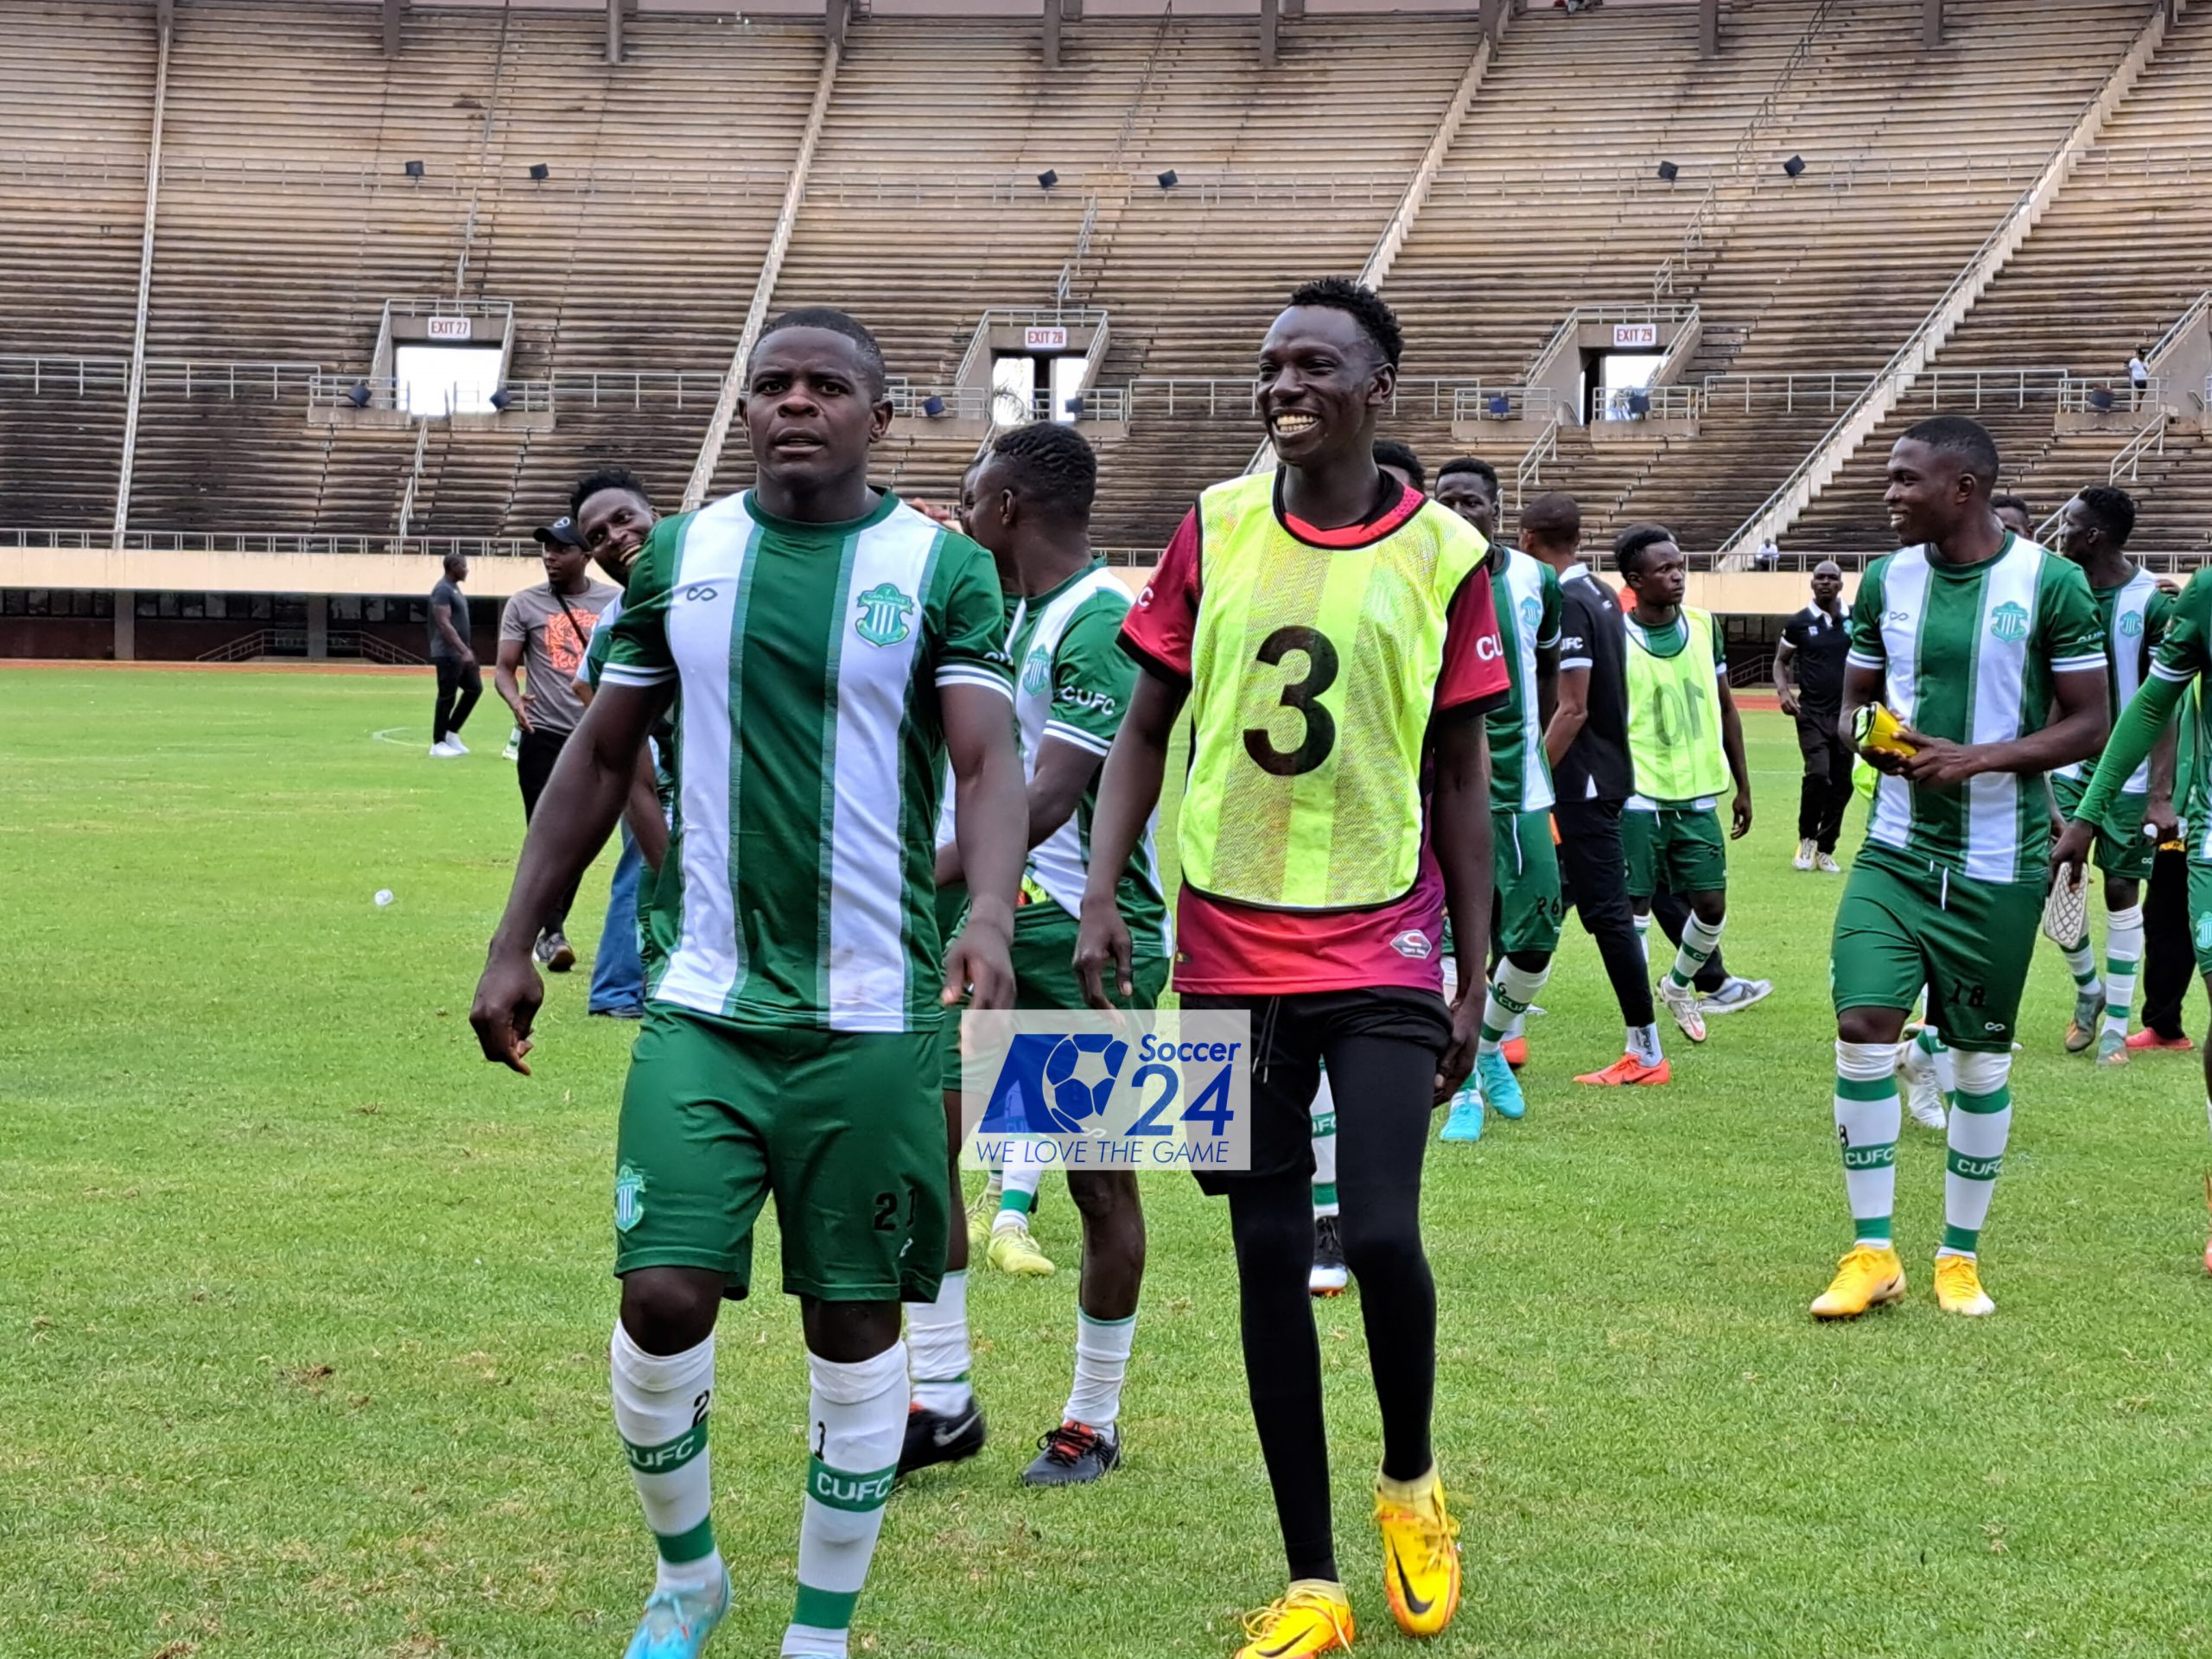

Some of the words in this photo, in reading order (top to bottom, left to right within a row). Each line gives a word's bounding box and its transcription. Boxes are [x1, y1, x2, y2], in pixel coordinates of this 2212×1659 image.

[431, 321, 454, 334] EXIT
[456, 321, 467, 334] 27
[1028, 331, 1051, 344] EXIT
[1616, 328, 1639, 342] EXIT
[1059, 684, 1116, 715] CUFC
[1243, 625, 1339, 776] 3
[1948, 978, 1986, 1007] 18
[1845, 1147, 1895, 1166] CUFC
[874, 1188, 916, 1231] 21
[816, 1471, 893, 1502] CUFC
